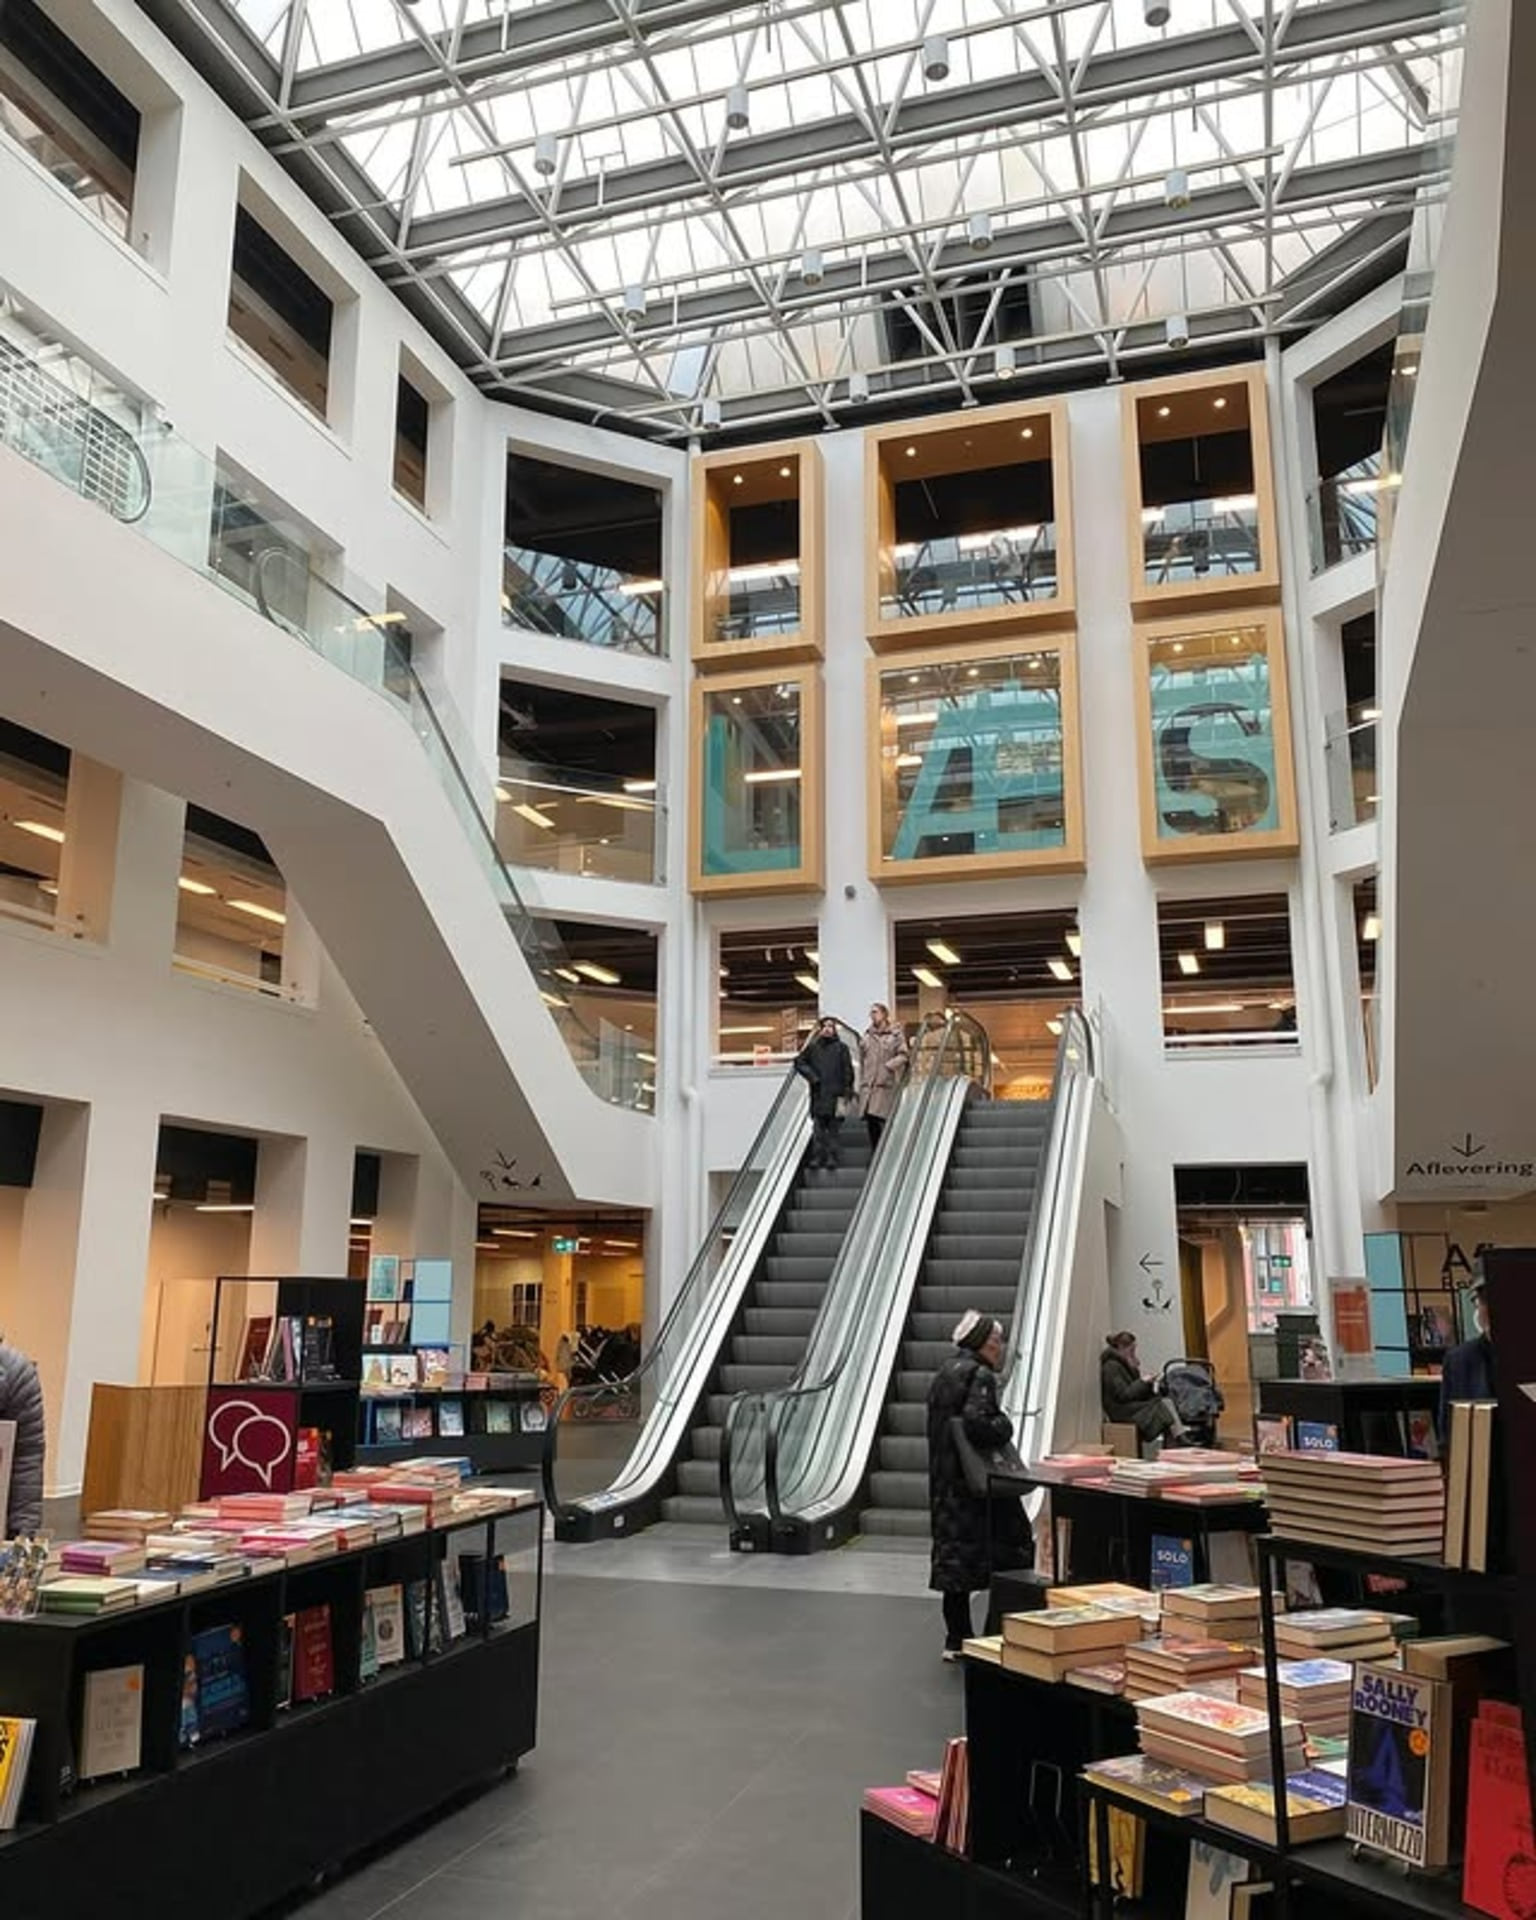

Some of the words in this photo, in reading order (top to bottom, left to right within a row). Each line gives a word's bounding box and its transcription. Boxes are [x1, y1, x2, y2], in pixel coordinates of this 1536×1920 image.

[1406, 1161, 1533, 1177] Aflevering
[1303, 1436, 1334, 1449] SOLO
[1156, 1549, 1189, 1564] SOLO
[1362, 1674, 1418, 1705] SALLY
[1354, 1690, 1427, 1727] ROONEY
